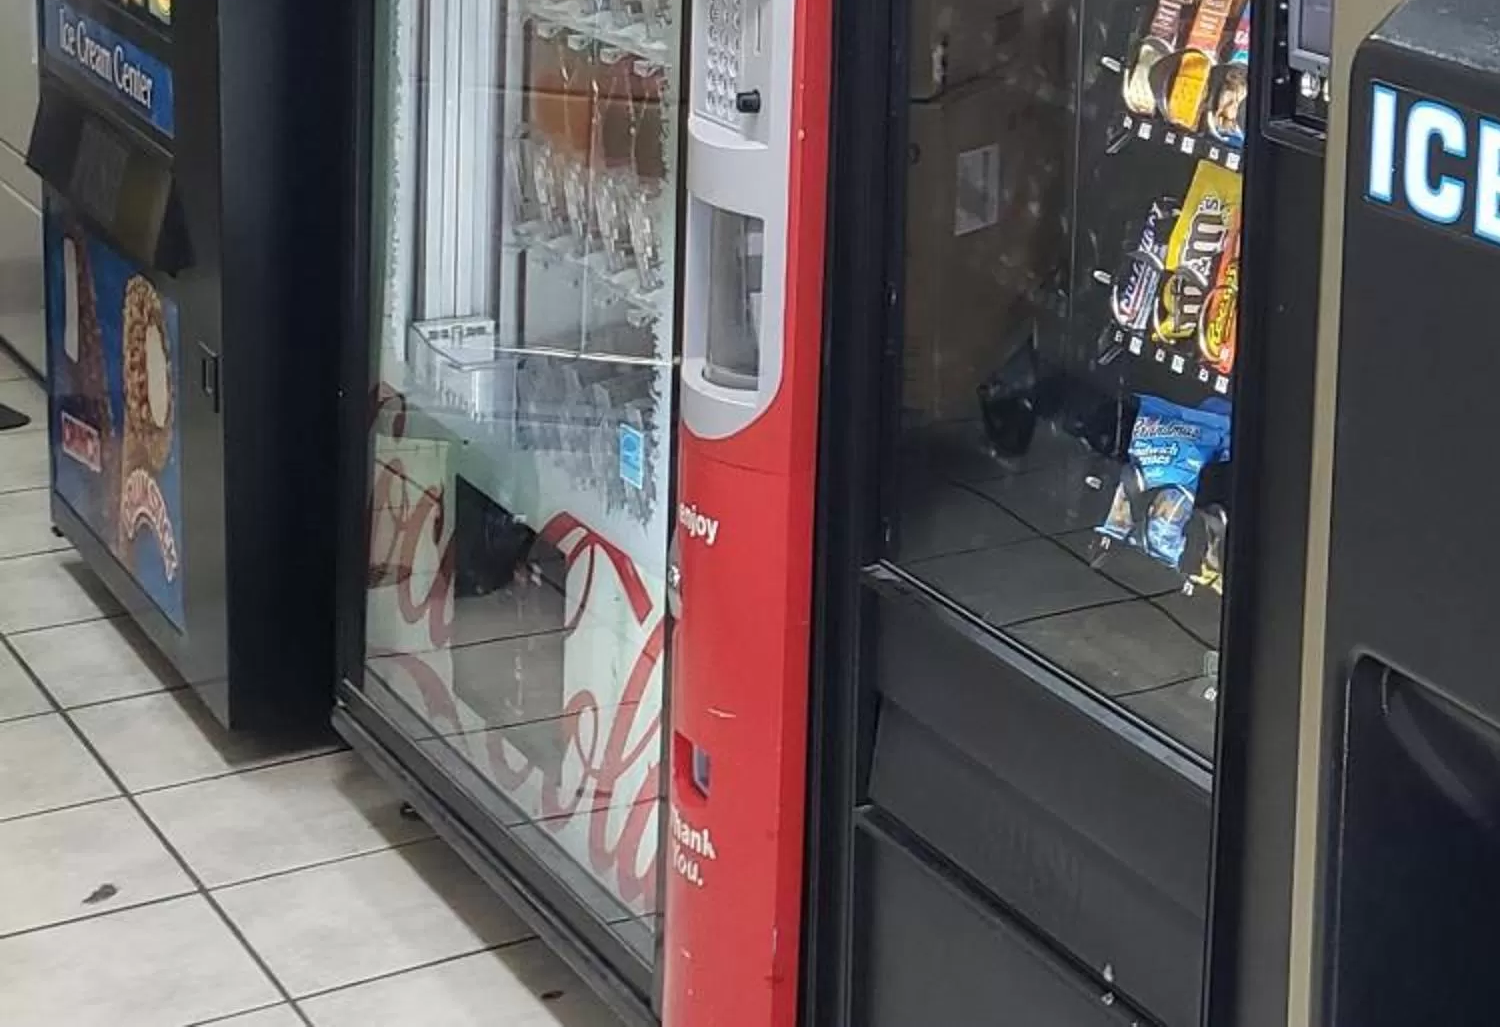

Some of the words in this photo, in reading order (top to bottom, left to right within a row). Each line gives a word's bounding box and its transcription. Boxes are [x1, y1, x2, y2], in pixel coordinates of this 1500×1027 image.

[59, 8, 76, 56] Ice
[77, 20, 113, 84] Cream
[113, 44, 153, 109] Center
